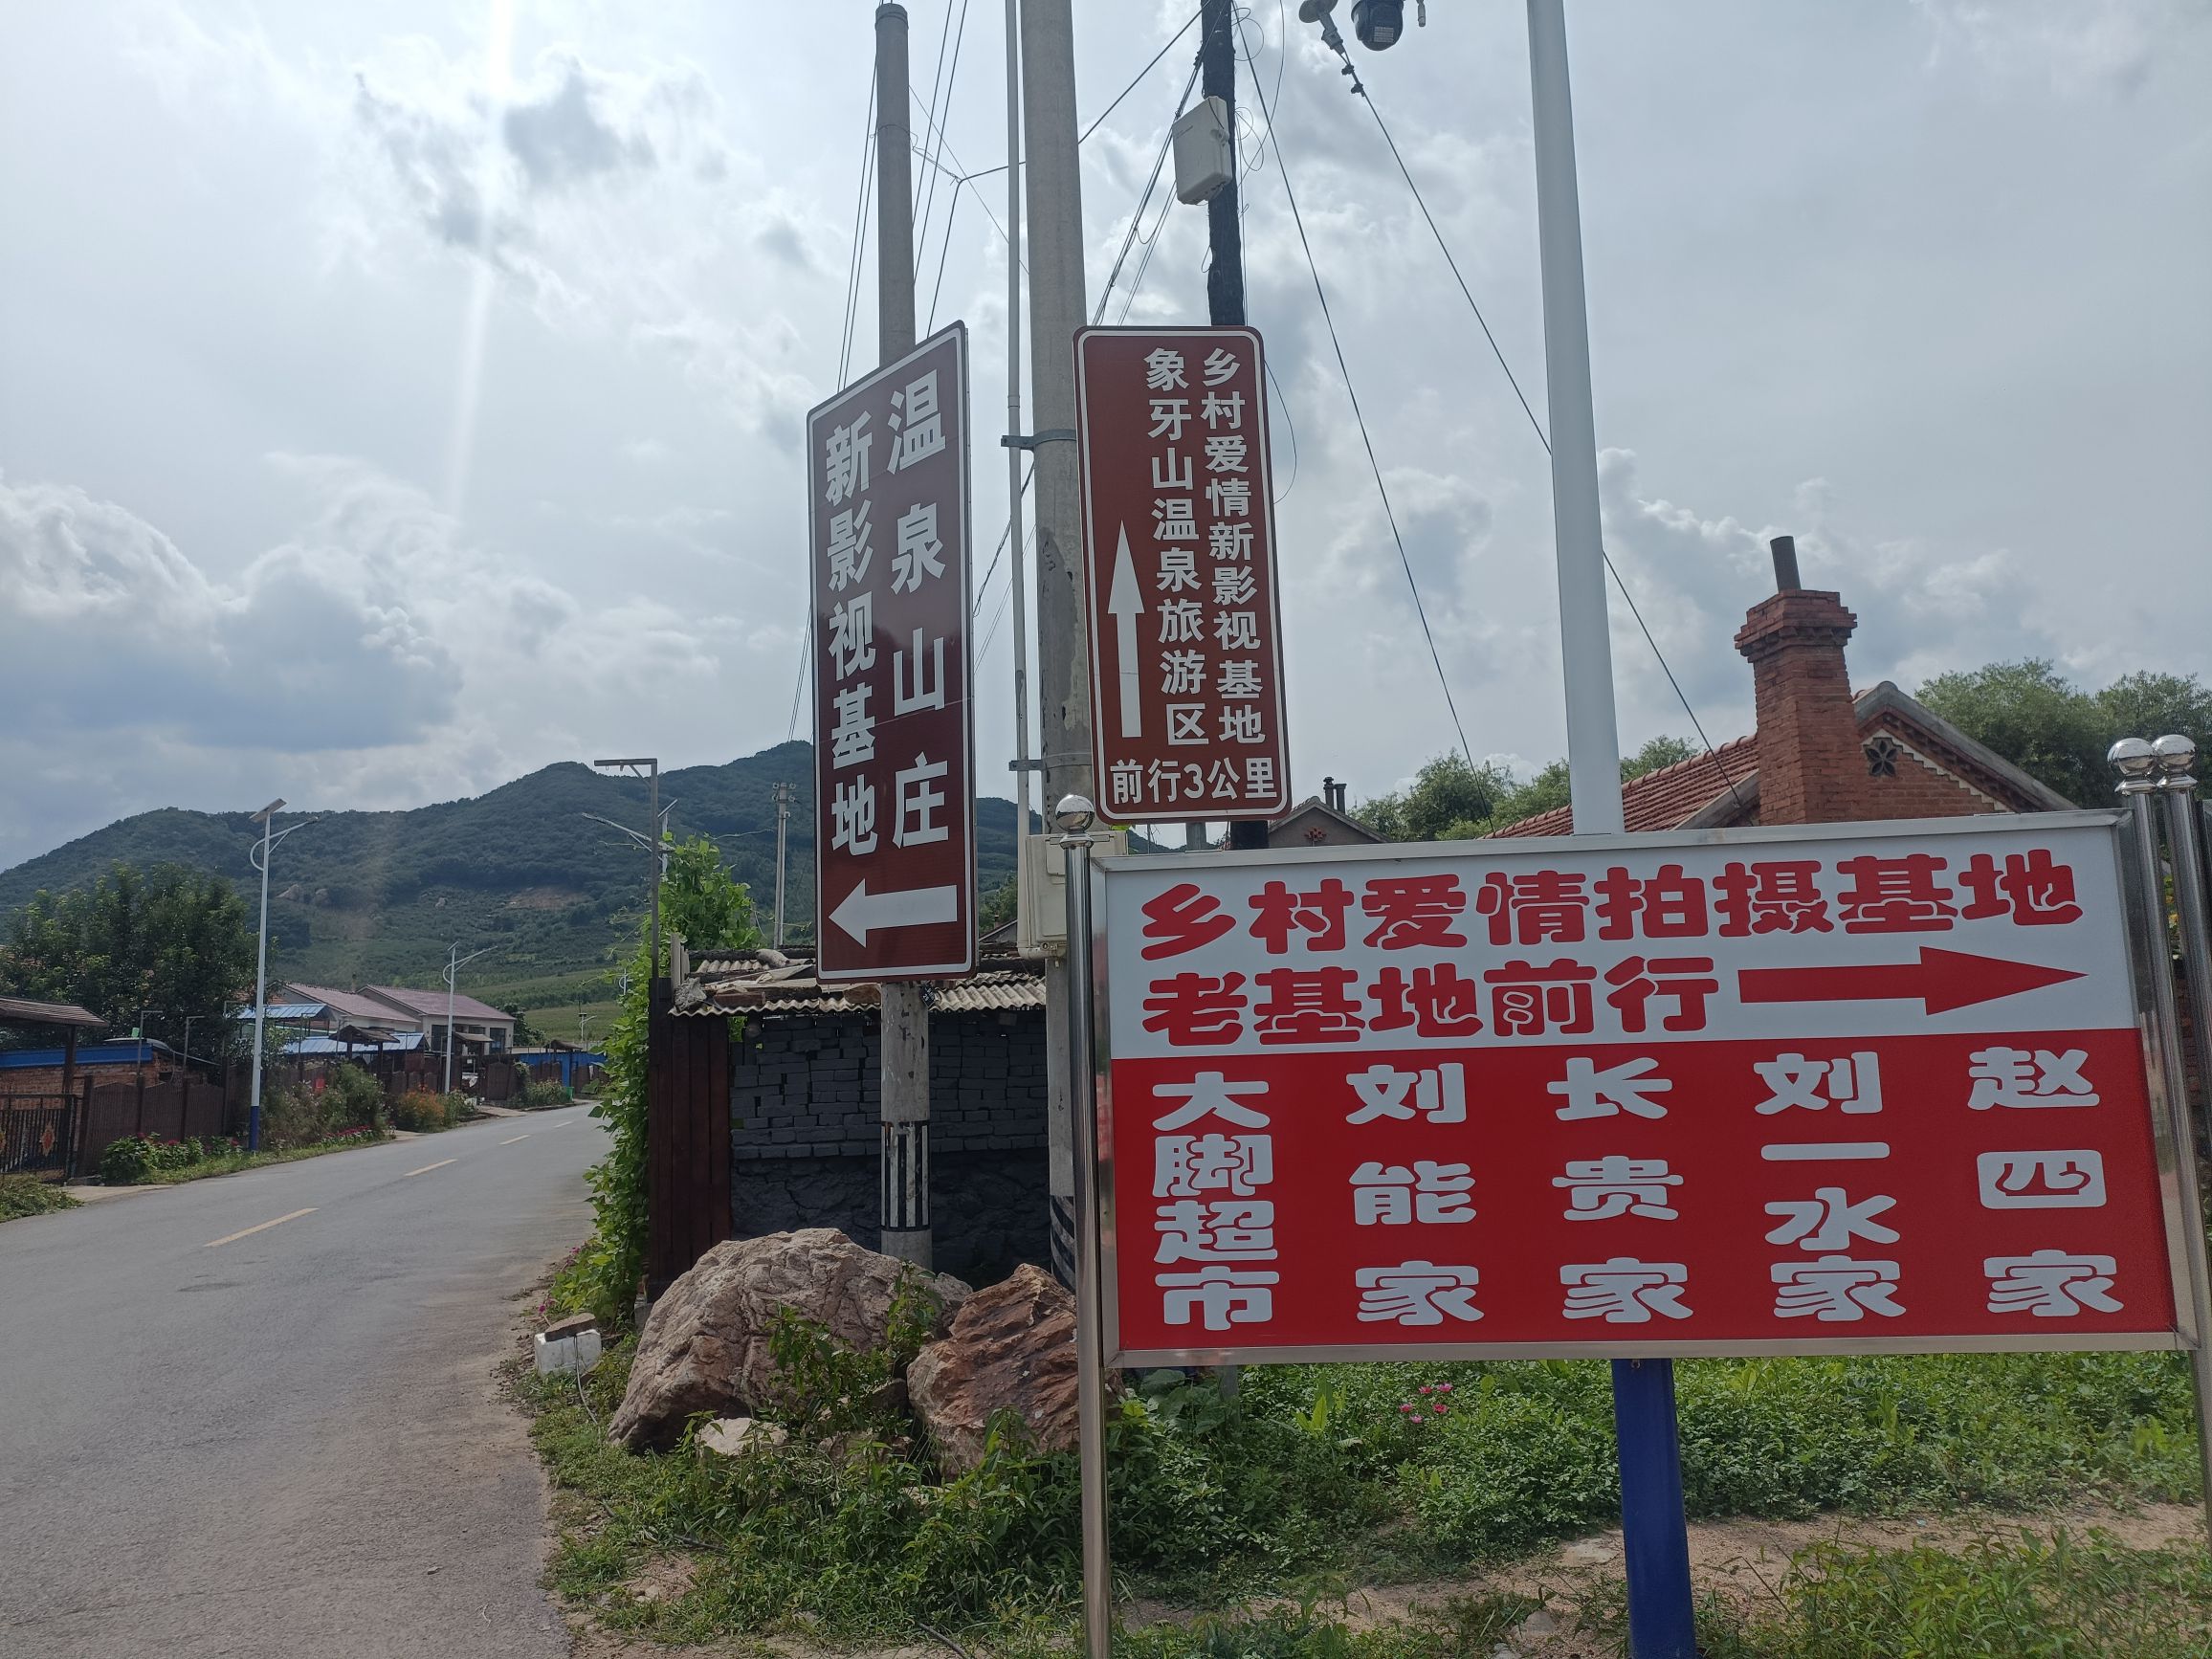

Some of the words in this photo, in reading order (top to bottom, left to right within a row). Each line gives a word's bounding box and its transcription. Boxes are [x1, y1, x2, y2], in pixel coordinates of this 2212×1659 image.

[825, 410, 878, 855] 新影视基地
[886, 368, 950, 849] 温泉山庄
[1143, 347, 1209, 746] 象牙山温泉旅游区
[1200, 347, 1266, 744] 乡村爱情新影视基地
[1110, 757, 1277, 805] 前行3公里
[1142, 848, 2084, 959] 乡村爱情拍摄基地
[1143, 956, 1719, 1046] 老基地前行
[1152, 1071, 1280, 1331] 大脚超市
[1345, 1062, 1485, 1327] 刘能家
[1546, 1057, 1693, 1323] 长贵家
[1753, 1051, 1907, 1321] 刘一水家
[1967, 1046, 2124, 1317] 赵四家
